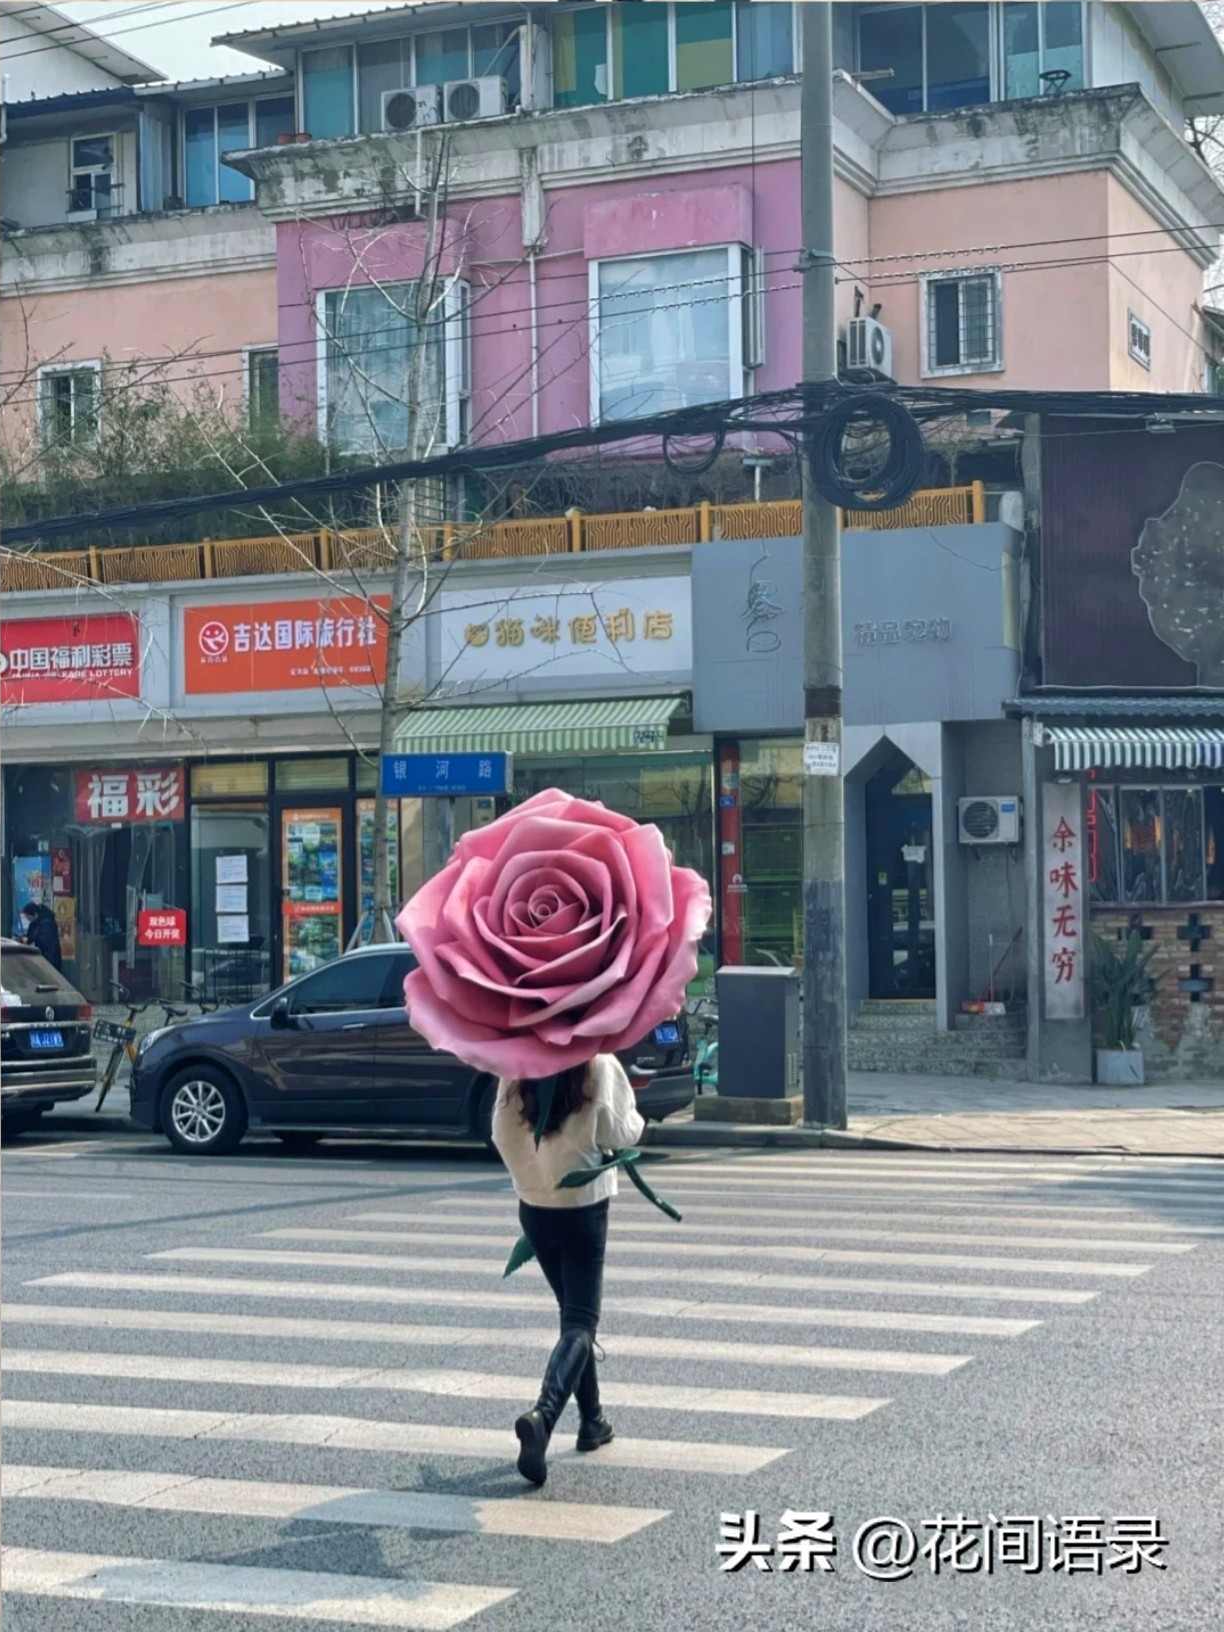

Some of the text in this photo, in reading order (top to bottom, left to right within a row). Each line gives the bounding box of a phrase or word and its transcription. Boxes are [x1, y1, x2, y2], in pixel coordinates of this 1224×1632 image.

[233, 615, 377, 652] 吉达国际旅行社
[494, 607, 673, 647] 猫咪便利店
[854, 618, 952, 646] 精品宠物
[9, 642, 133, 670] 中国福利彩票
[89, 668, 133, 678] LOTTERY
[392, 759, 493, 780] 银河路
[87, 771, 180, 819] 福彩
[1048, 816, 1078, 986] 余味无穷
